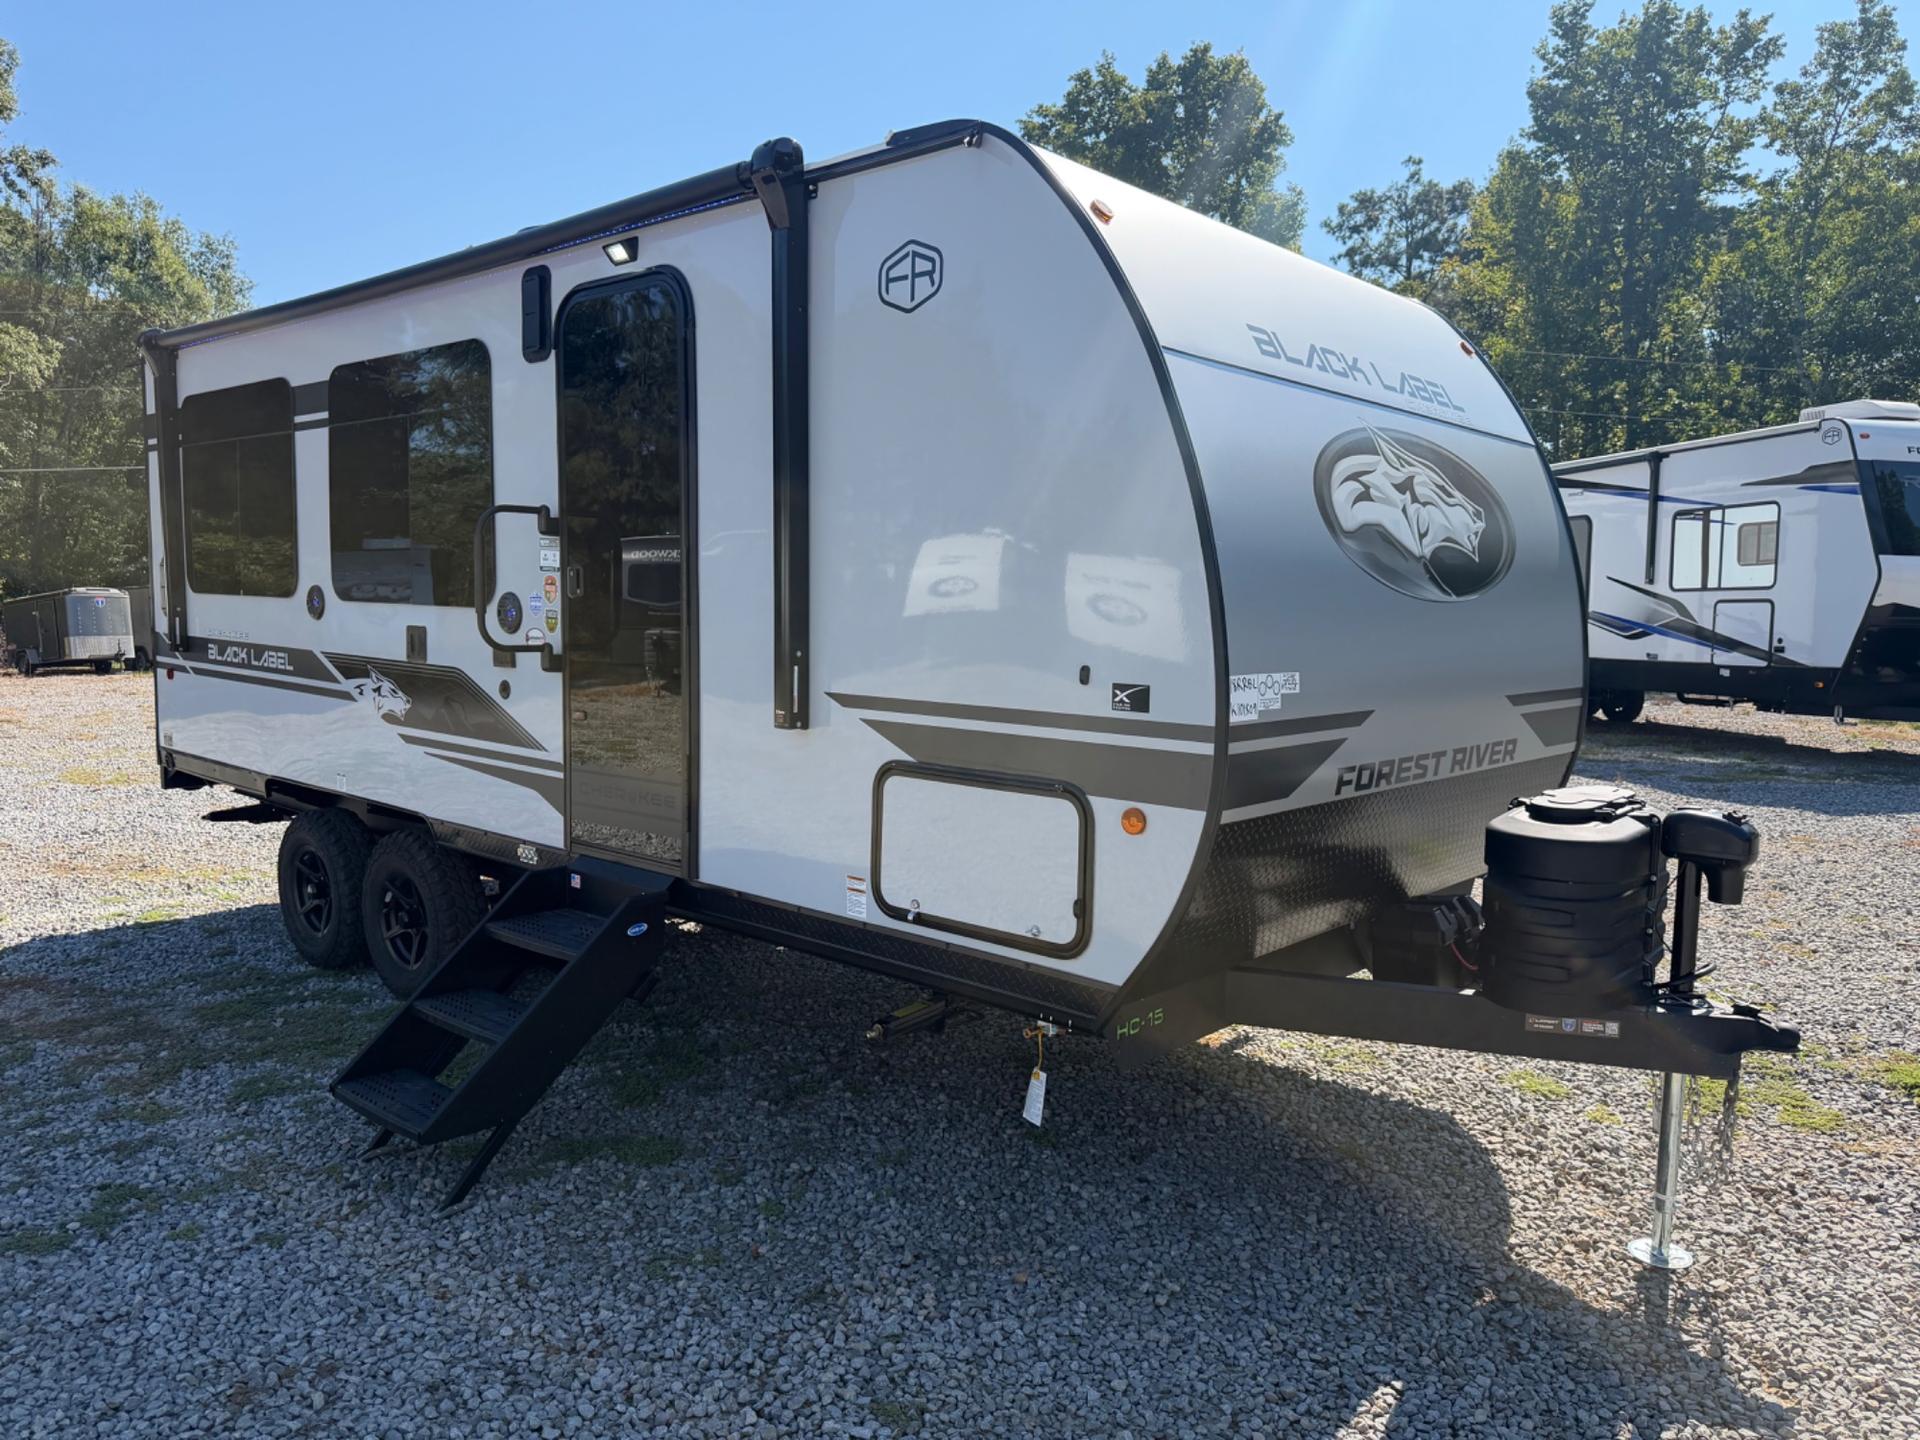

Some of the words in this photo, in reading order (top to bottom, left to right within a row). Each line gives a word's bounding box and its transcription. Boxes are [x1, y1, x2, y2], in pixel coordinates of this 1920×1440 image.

[1246, 323, 1372, 386] BLACK
[1369, 361, 1466, 413] LABEL
[207, 643, 248, 664] BLACK
[250, 648, 294, 671] LABEL
[1334, 750, 1447, 797] FOREST
[1450, 738, 1519, 774] RIVER
[1117, 1008, 1164, 1040] HC-15
